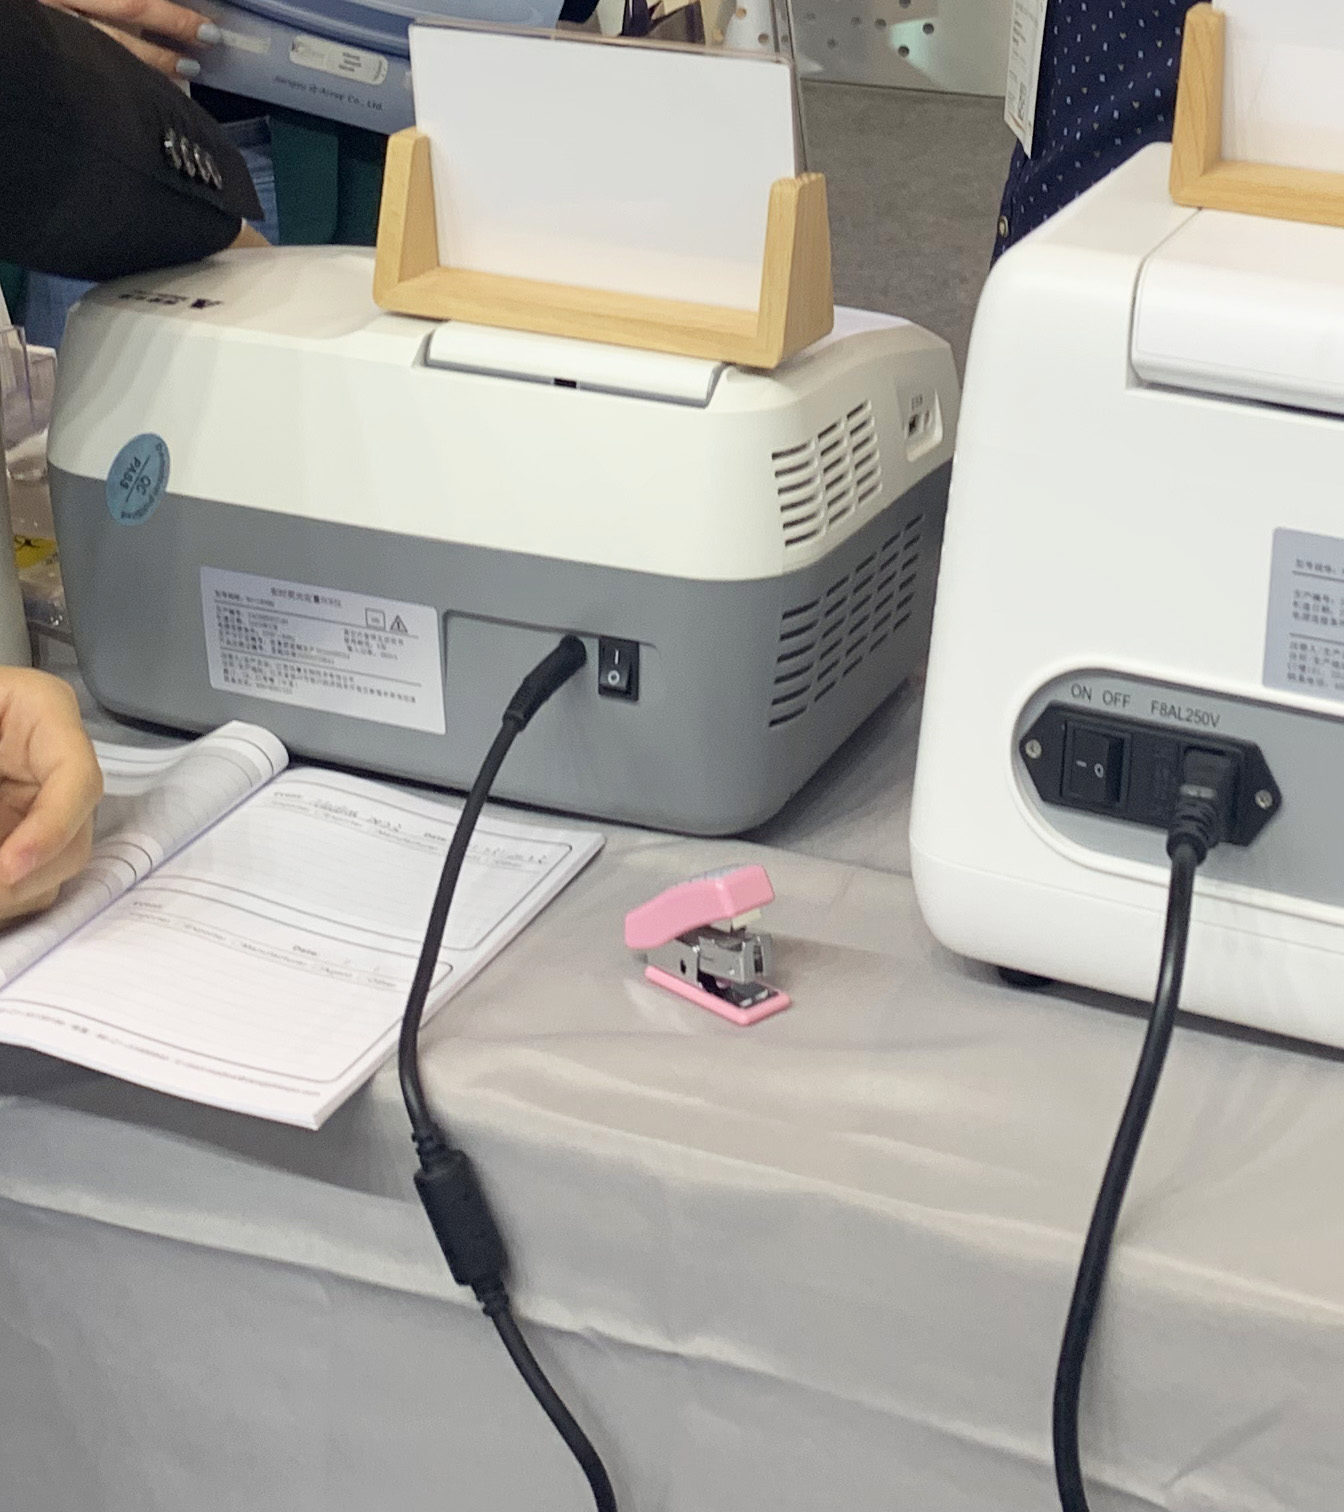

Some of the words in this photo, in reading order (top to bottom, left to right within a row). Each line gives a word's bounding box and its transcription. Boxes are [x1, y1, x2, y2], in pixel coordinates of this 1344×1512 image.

[1070, 683, 1093, 701] ON
[1102, 689, 1131, 708] OFF
[1151, 700, 1221, 728] F8AL250V
